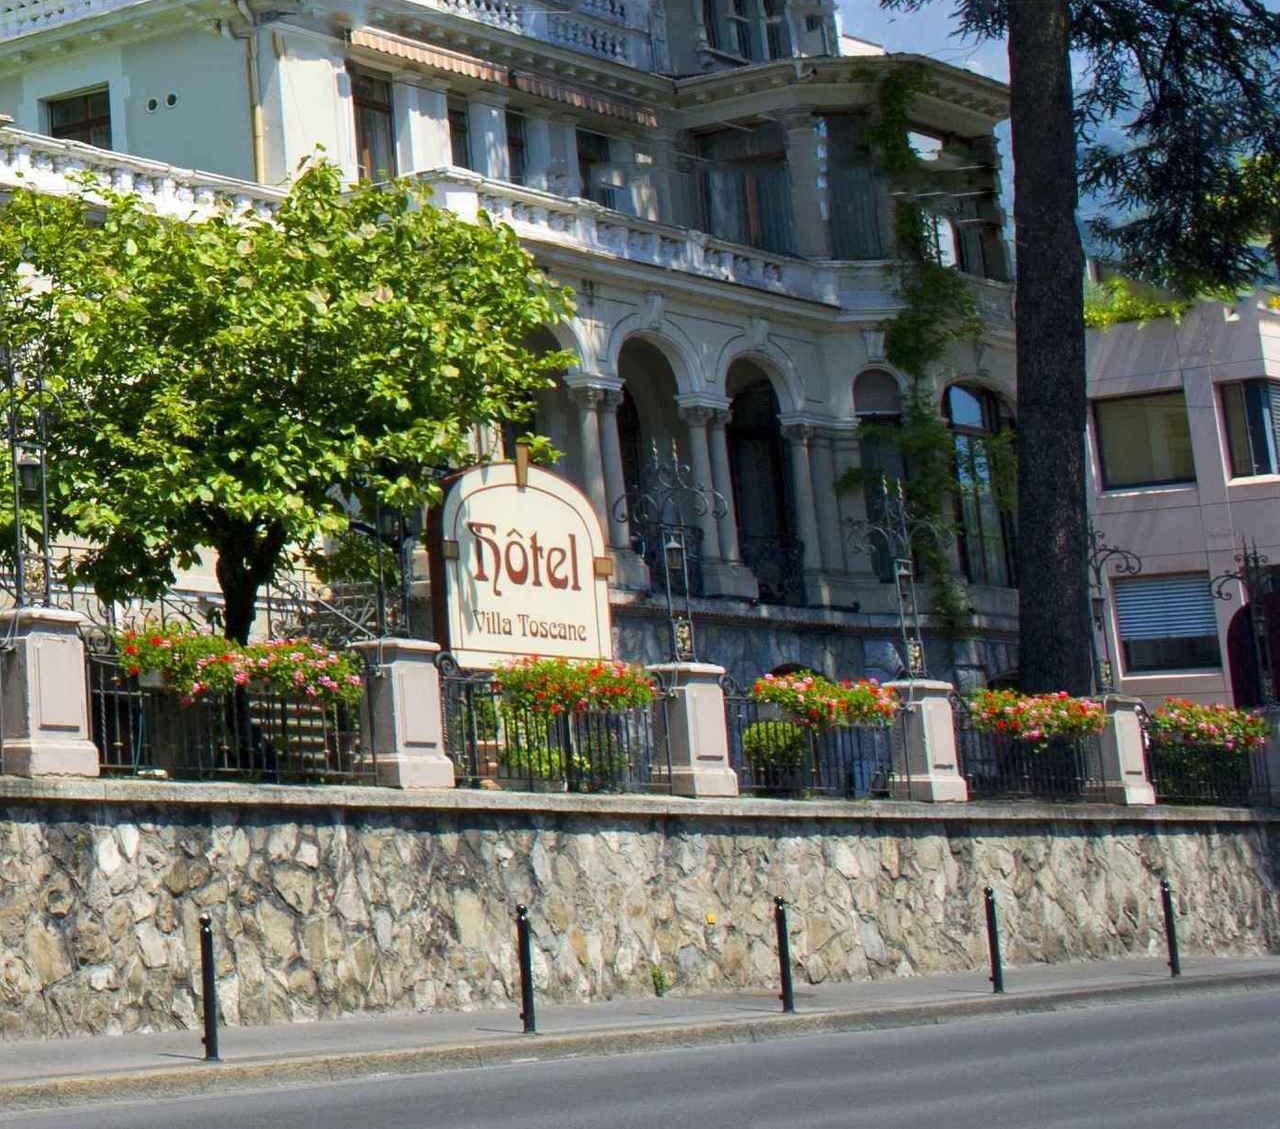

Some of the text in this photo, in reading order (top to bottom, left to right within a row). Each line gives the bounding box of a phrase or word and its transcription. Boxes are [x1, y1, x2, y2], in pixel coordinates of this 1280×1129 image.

[466, 521, 582, 597] Hôtel
[472, 609, 588, 642] Villa Toscane
